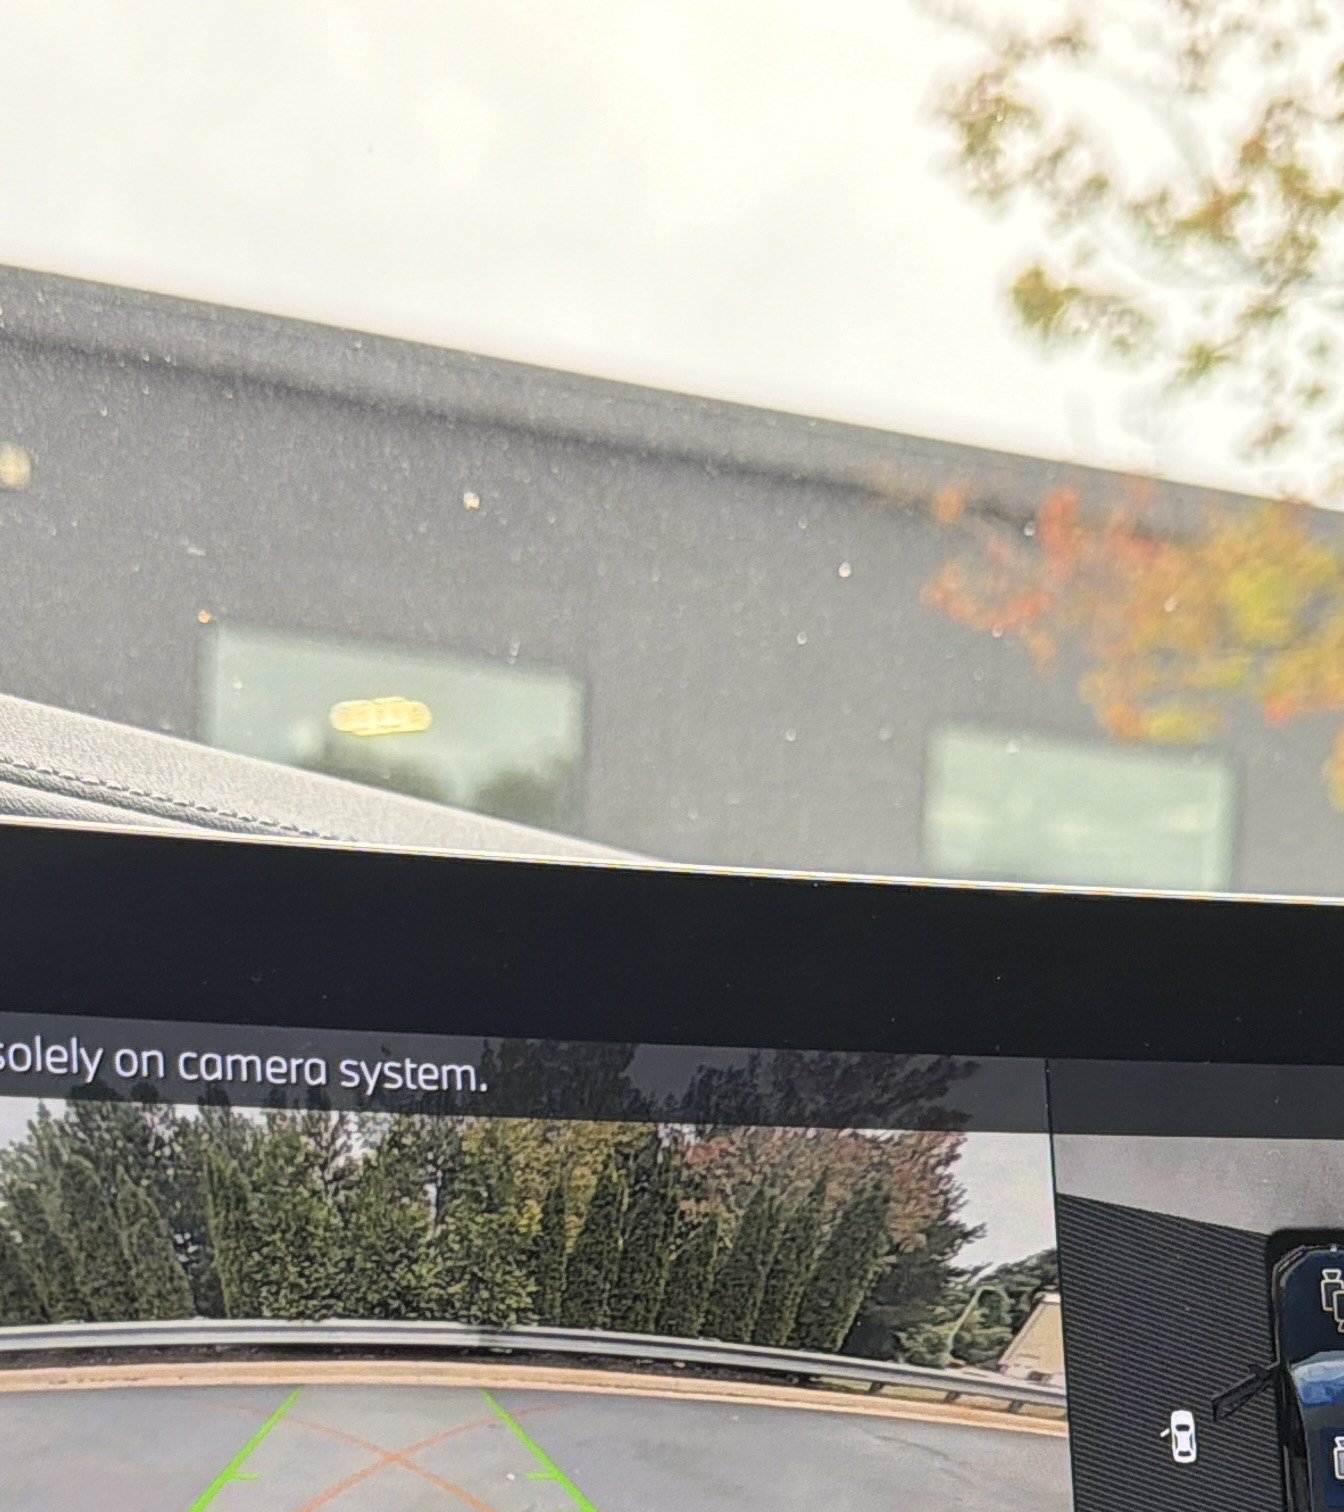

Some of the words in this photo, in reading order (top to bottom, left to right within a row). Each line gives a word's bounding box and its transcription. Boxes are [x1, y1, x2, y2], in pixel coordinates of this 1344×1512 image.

[114, 1050, 165, 1080] on
[177, 1053, 327, 1086] camera
[339, 1059, 489, 1098] system.
